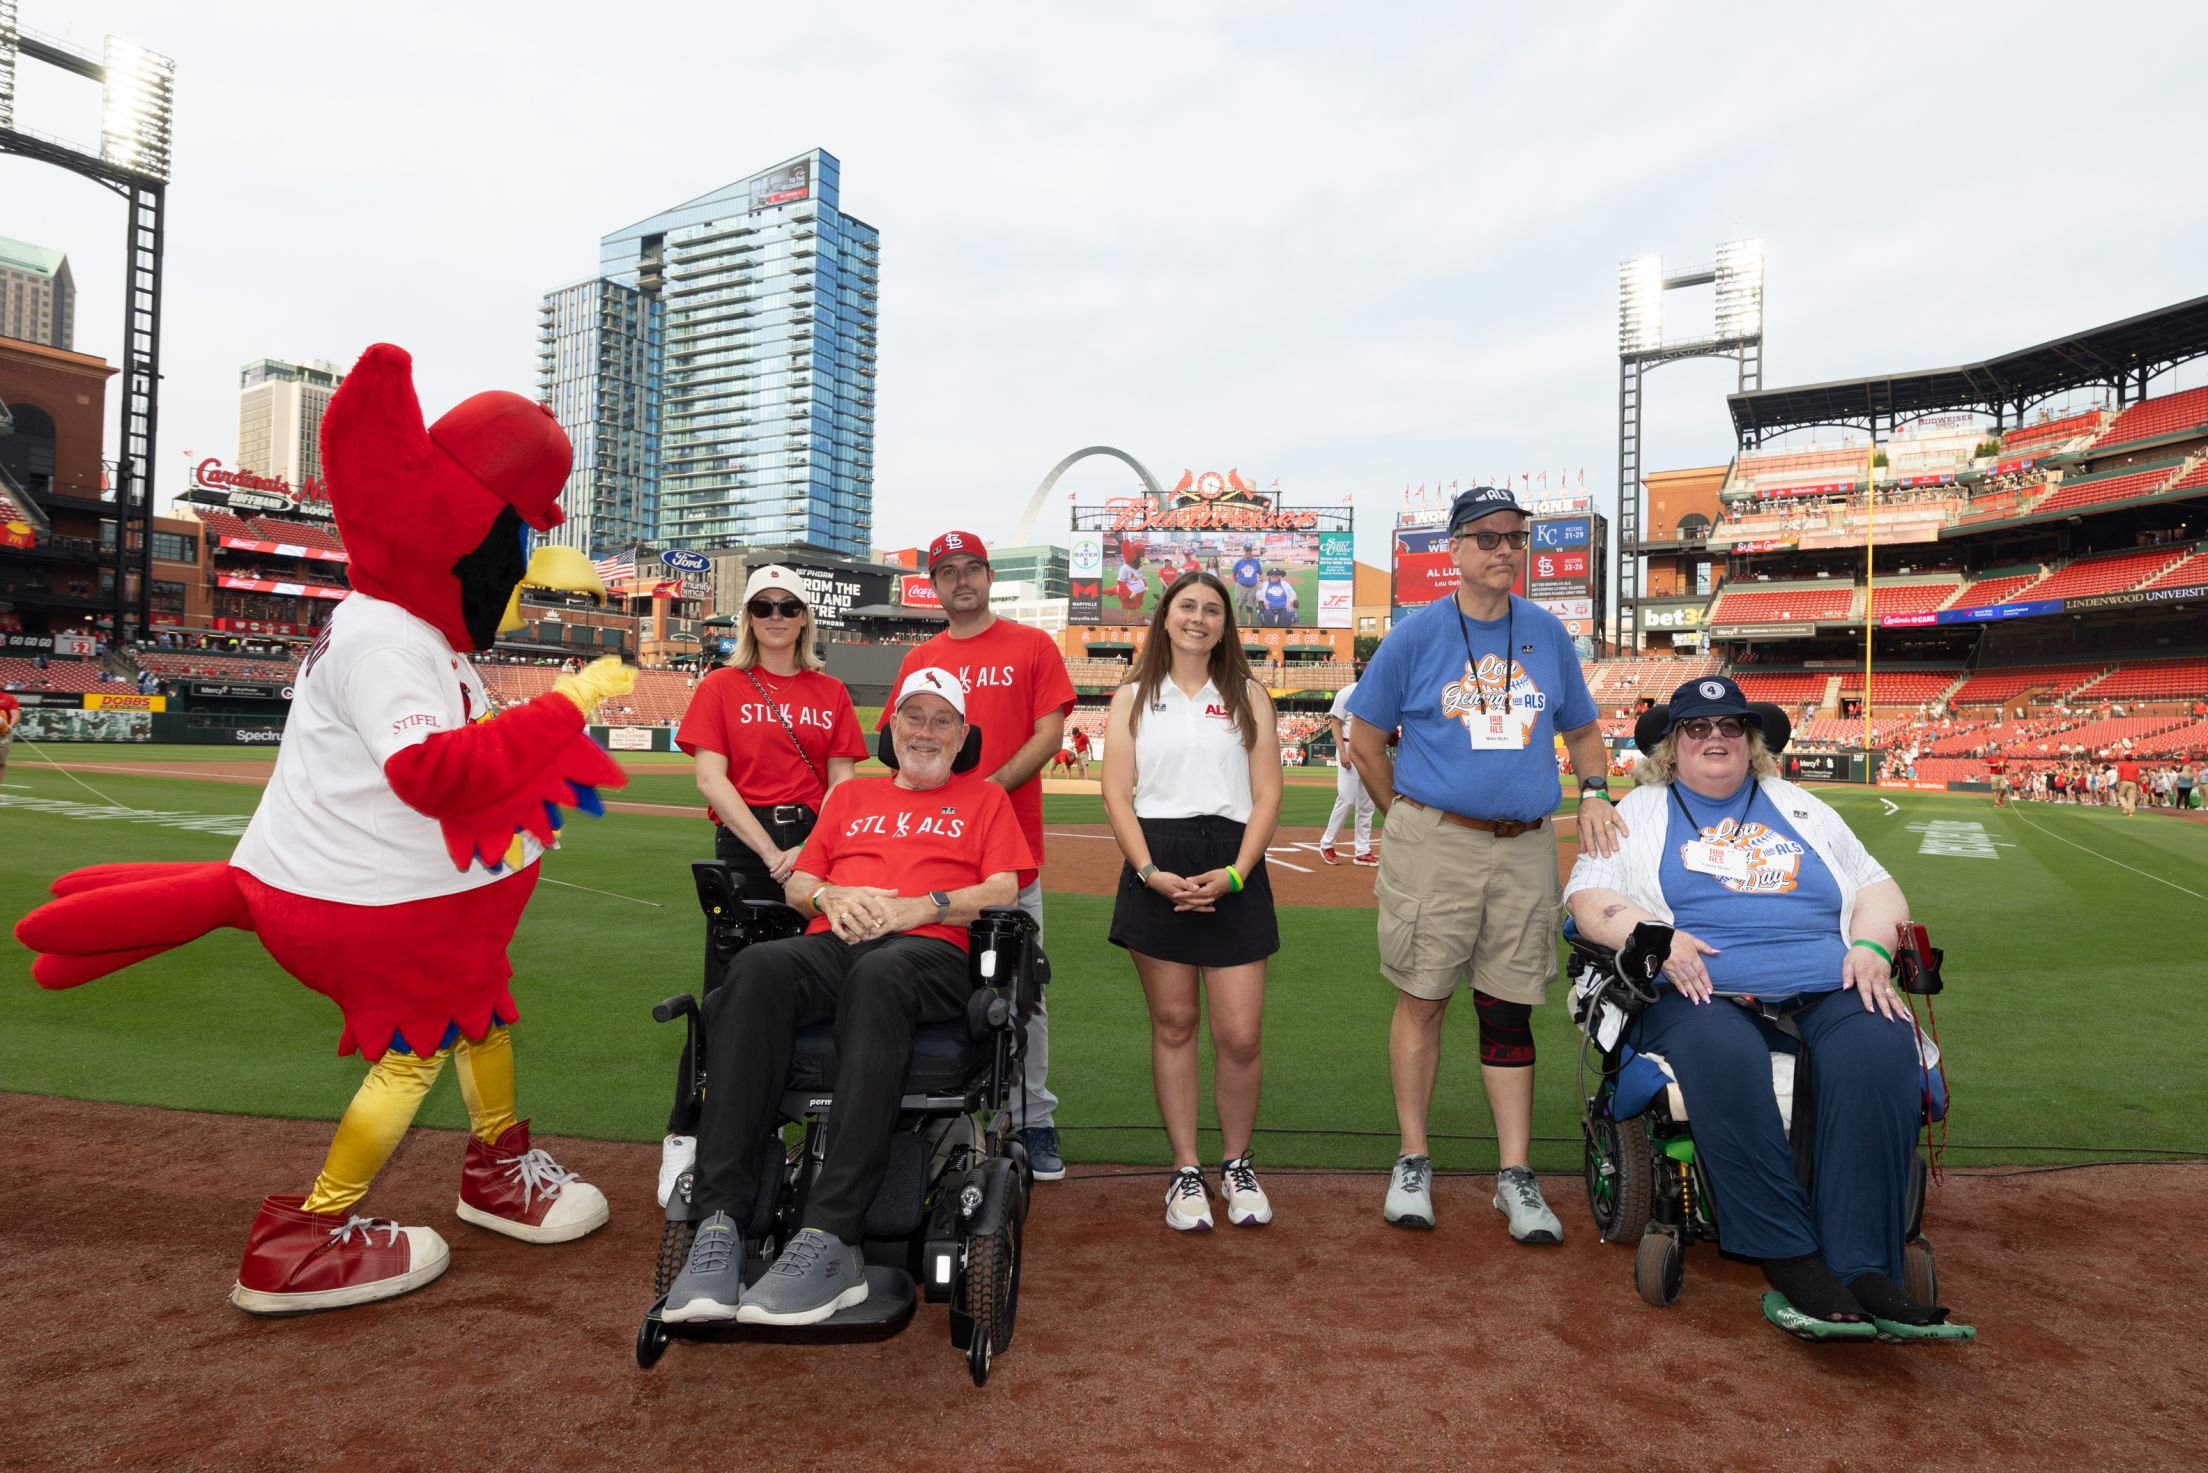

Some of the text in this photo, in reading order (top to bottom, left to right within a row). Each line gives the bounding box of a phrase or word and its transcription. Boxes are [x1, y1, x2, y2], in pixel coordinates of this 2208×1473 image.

[1918, 414, 1973, 425] BUDWEISER
[196, 458, 291, 495] Cardinals
[1105, 496, 1319, 532] Budweiser
[1537, 524, 1557, 545] KC
[1564, 531, 1584, 539] 31-29
[672, 552, 703, 569] Ford
[1564, 563, 1583, 571] 33-26
[1426, 569, 1440, 578] AL
[835, 581, 861, 596] THE
[823, 592, 852, 607] AND
[2066, 586, 2208, 608] LINDENWOOD UNIVERSIT
[9, 635, 24, 646] GO
[24, 636, 38, 646] GO
[38, 637, 53, 647] GO
[976, 665, 1014, 688] ALS
[201, 686, 223, 695] Mercy
[1707, 685, 1716, 695] 4
[102, 696, 150, 706] DOBBS
[1524, 694, 1544, 708] ALS
[740, 703, 777, 723] STL
[799, 706, 833, 730] ALS
[392, 714, 441, 735] STIFEL
[236, 729, 283, 743] Spectru
[1800, 760, 1816, 768] Mercy
[846, 815, 886, 837] STL
[916, 816, 965, 838] ALS
[1776, 842, 1801, 855] ALS
